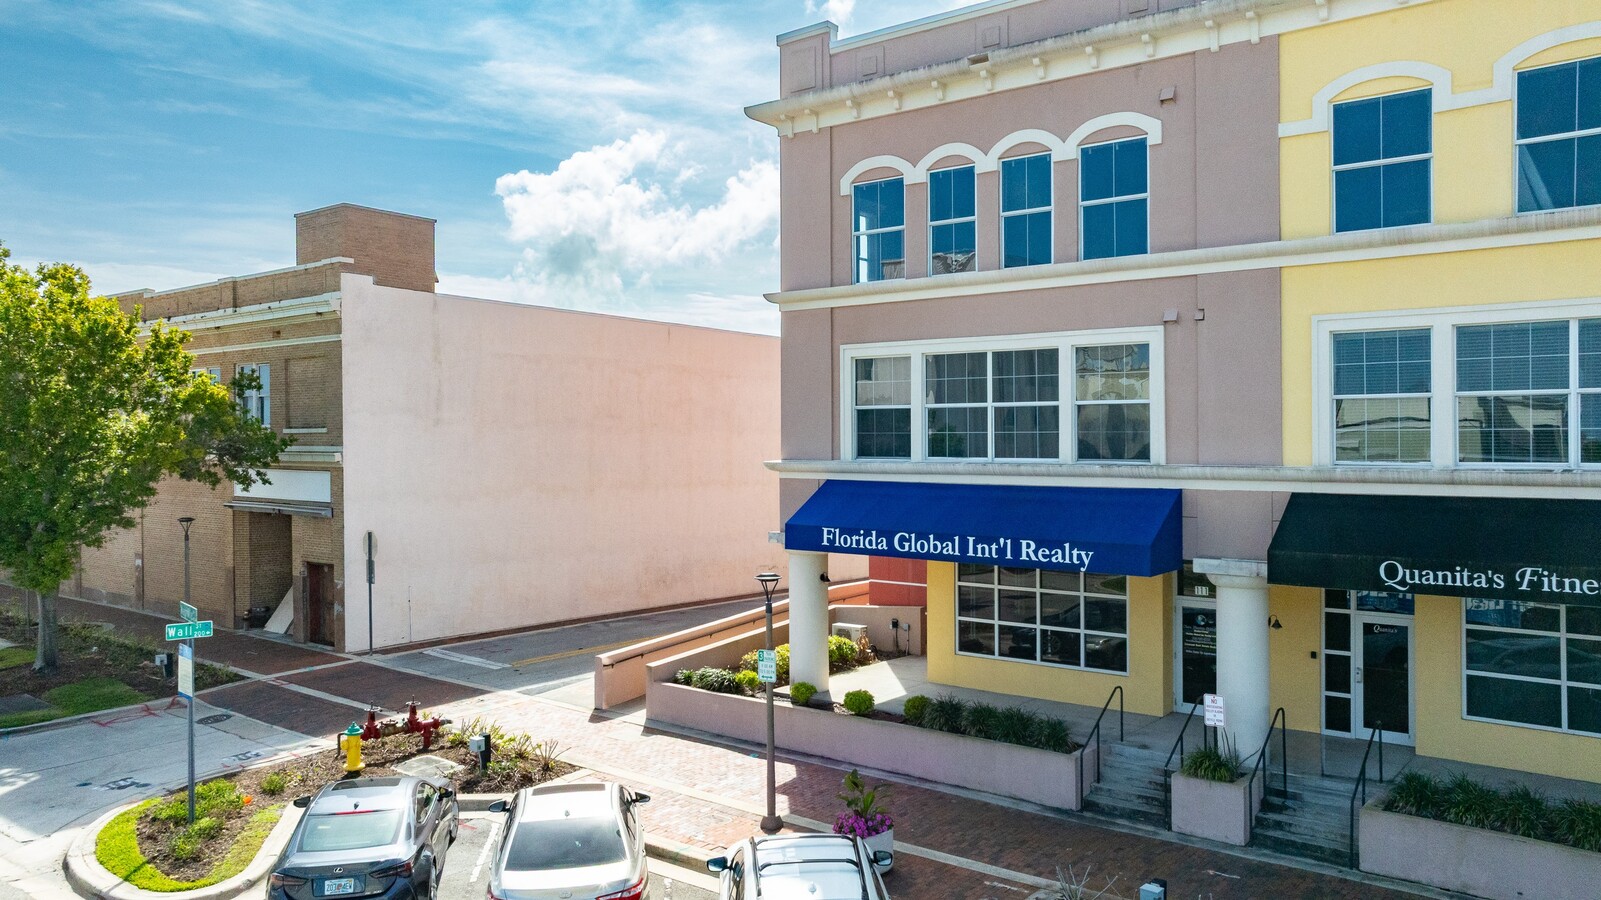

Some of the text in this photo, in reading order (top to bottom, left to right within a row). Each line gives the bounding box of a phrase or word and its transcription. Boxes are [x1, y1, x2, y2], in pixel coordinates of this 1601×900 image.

[821, 527, 1094, 572] Florida Global Int'l Realty
[1379, 560, 1601, 596] Quanita's Fitne
[1194, 585, 1209, 596] 111
[168, 626, 193, 638] Wall
